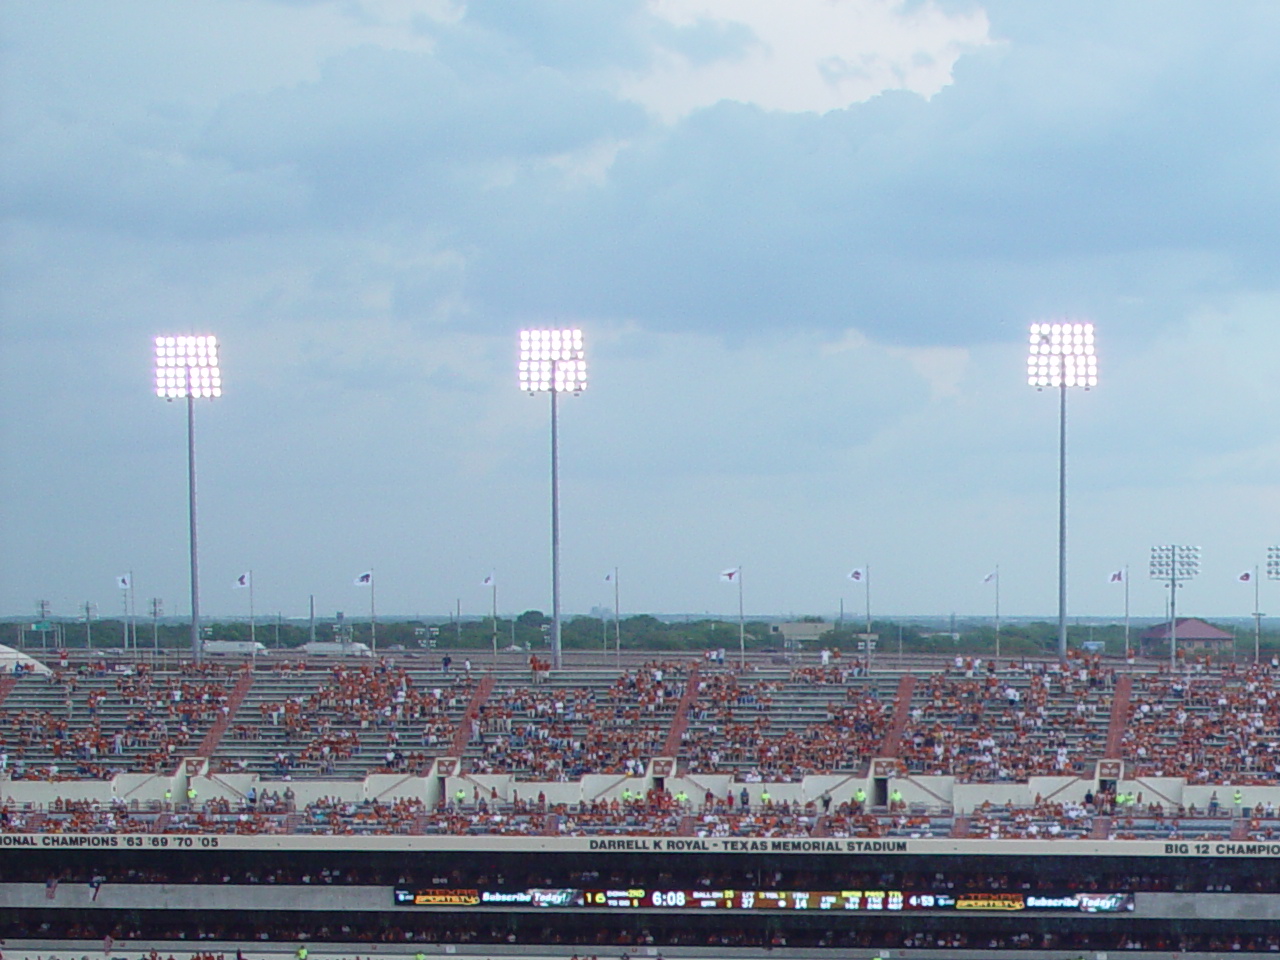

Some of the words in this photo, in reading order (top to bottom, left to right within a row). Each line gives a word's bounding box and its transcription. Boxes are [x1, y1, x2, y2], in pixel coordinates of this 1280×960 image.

[42, 836, 118, 847] CHAMPIONS
[123, 837, 143, 847] '63
[173, 837, 193, 847] '70
[198, 837, 219, 847] '05
[589, 840, 649, 850] DARRELL
[653, 840, 662, 850] K
[666, 840, 709, 851] ROYAL
[722, 840, 768, 851] TEXAS
[771, 840, 843, 851] MEMORIAL
[846, 841, 907, 851] STADIUM
[1164, 844, 1188, 854] BIG
[1194, 844, 1210, 854] 12
[652, 891, 685, 906] 6:08
[742, 900, 754, 908] 37
[795, 900, 807, 909] 14
